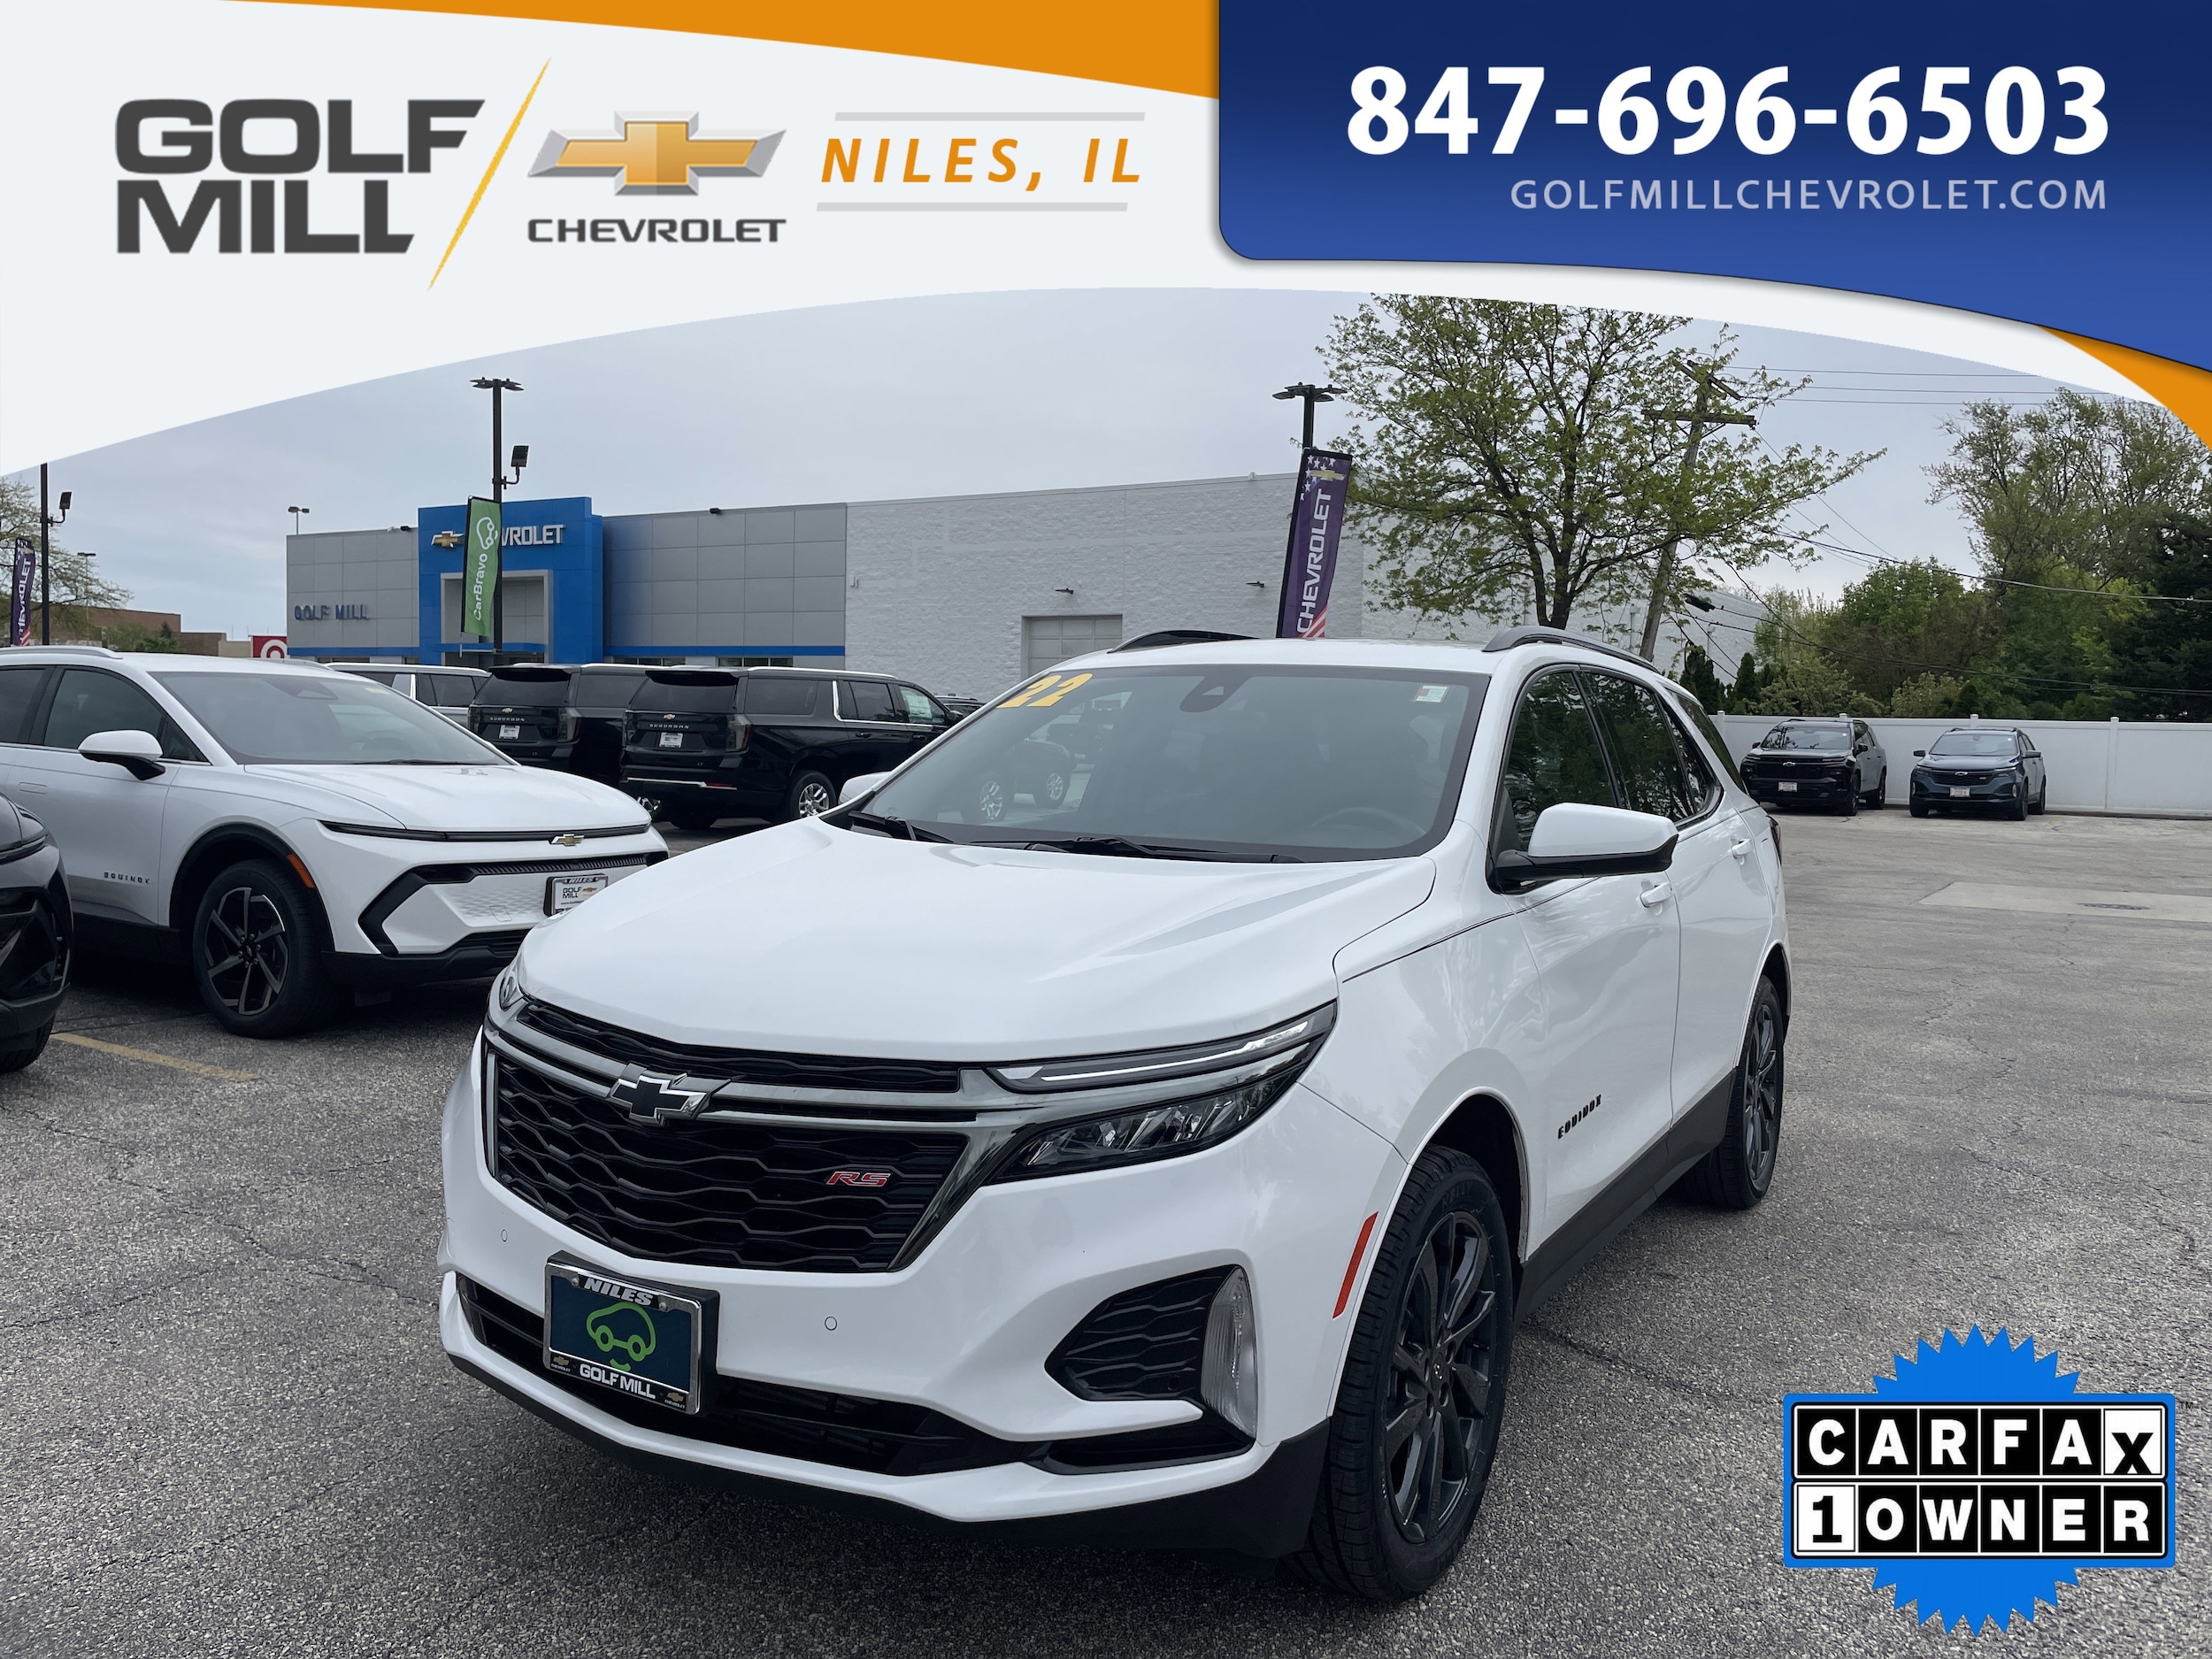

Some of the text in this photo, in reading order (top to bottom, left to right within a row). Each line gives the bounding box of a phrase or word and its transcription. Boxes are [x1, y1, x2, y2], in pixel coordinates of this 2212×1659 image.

[502, 524, 565, 547] VROLET
[1296, 488, 1332, 634] CHEVROLET
[472, 553, 488, 621] CarBravo
[295, 604, 370, 621] GOLF MILL
[995, 672, 1094, 709] 22
[1557, 1094, 1601, 1140] EQUINOX
[826, 1171, 892, 1187] RS
[583, 1277, 654, 1307] NILES
[579, 1363, 656, 1400] GOLF MILL
